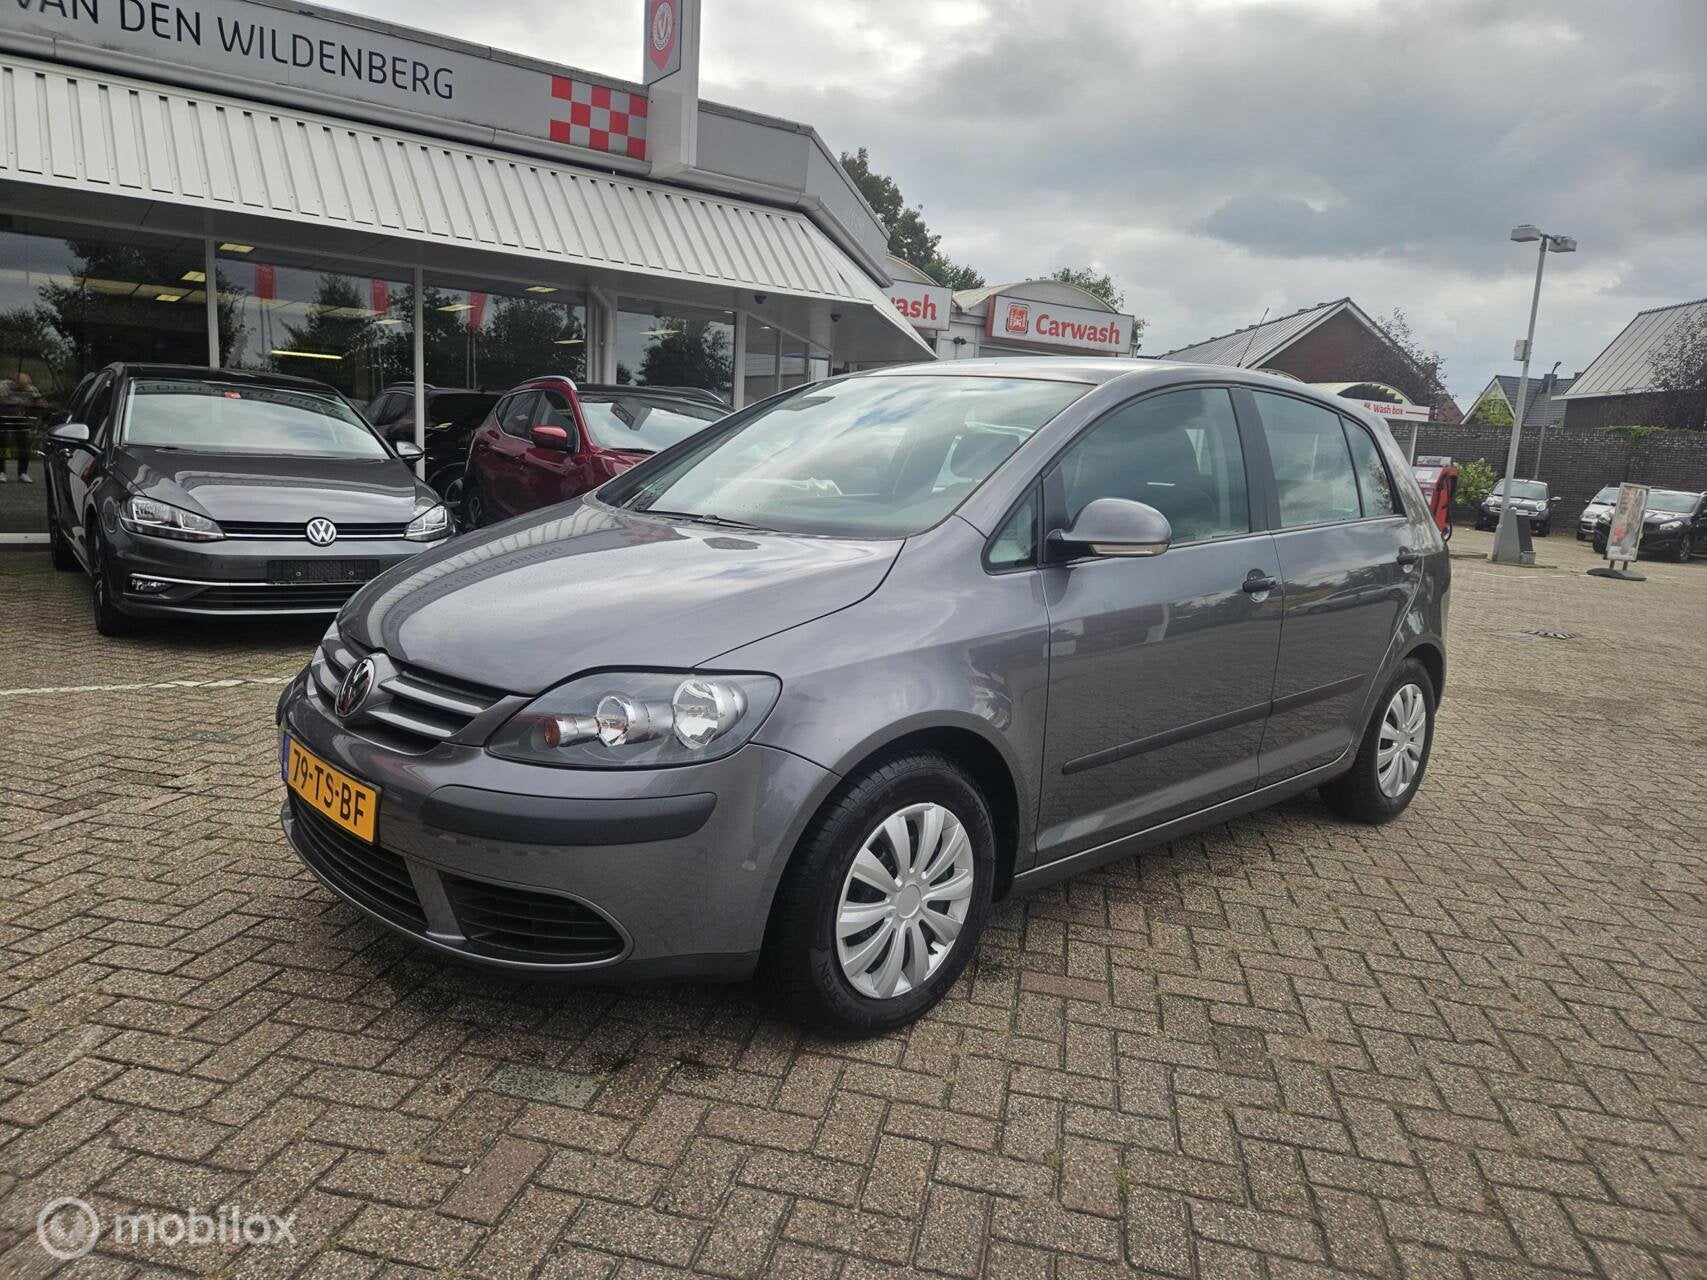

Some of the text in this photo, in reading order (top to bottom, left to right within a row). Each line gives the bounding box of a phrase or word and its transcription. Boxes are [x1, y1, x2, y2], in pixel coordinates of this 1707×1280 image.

[16, 0, 454, 100] AN DEN WILDENBERG
[890, 294, 937, 321] ash
[1035, 313, 1121, 345] Carwash
[1373, 403, 1404, 415] Wash box
[293, 748, 367, 827] 79-TS-BF
